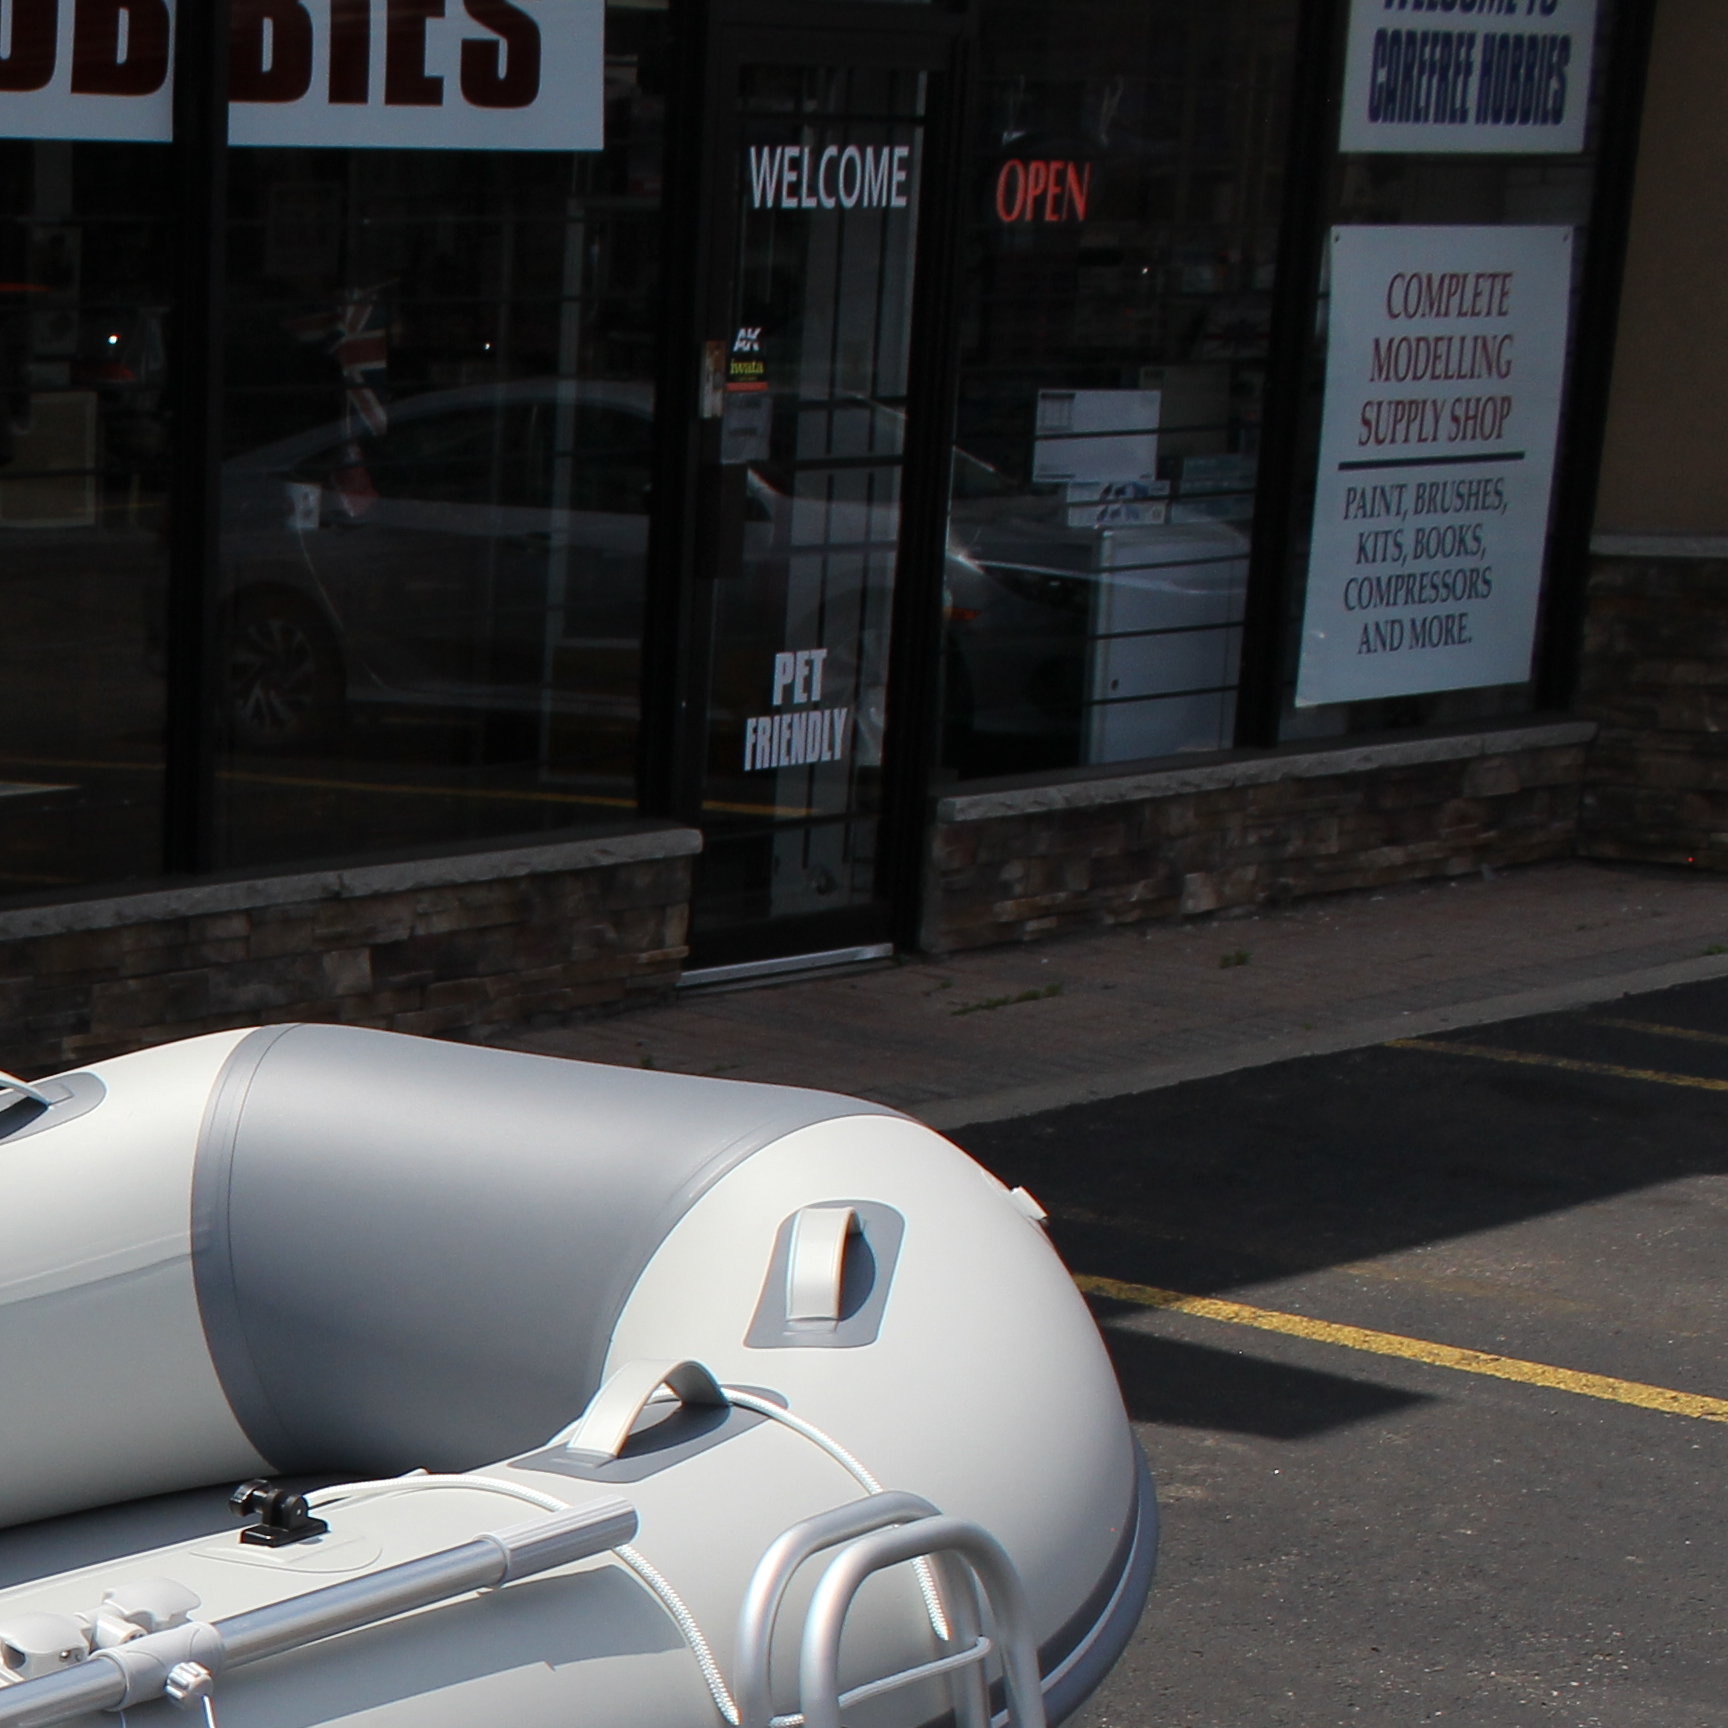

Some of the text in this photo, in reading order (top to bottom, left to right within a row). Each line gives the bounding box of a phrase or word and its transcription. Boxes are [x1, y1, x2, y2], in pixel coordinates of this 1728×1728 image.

[1368, 27, 1572, 126] CAREFREE HOBBIES
[749, 144, 911, 210] WELCOME
[996, 158, 1092, 223] OPEN
[1387, 271, 1514, 320] COMPLETE
[1370, 333, 1514, 383] MODELLING
[1358, 395, 1512, 447] SUPPLY SHOP
[1344, 476, 1509, 522] PAINT, BRUSHES,
[1356, 522, 1487, 568] KITS, BOOKS,
[1344, 565, 1493, 612] COMPRESSORS
[1357, 612, 1473, 655] AND MORE.
[772, 647, 829, 707] PET
[744, 706, 849, 773] FRIENDLY
